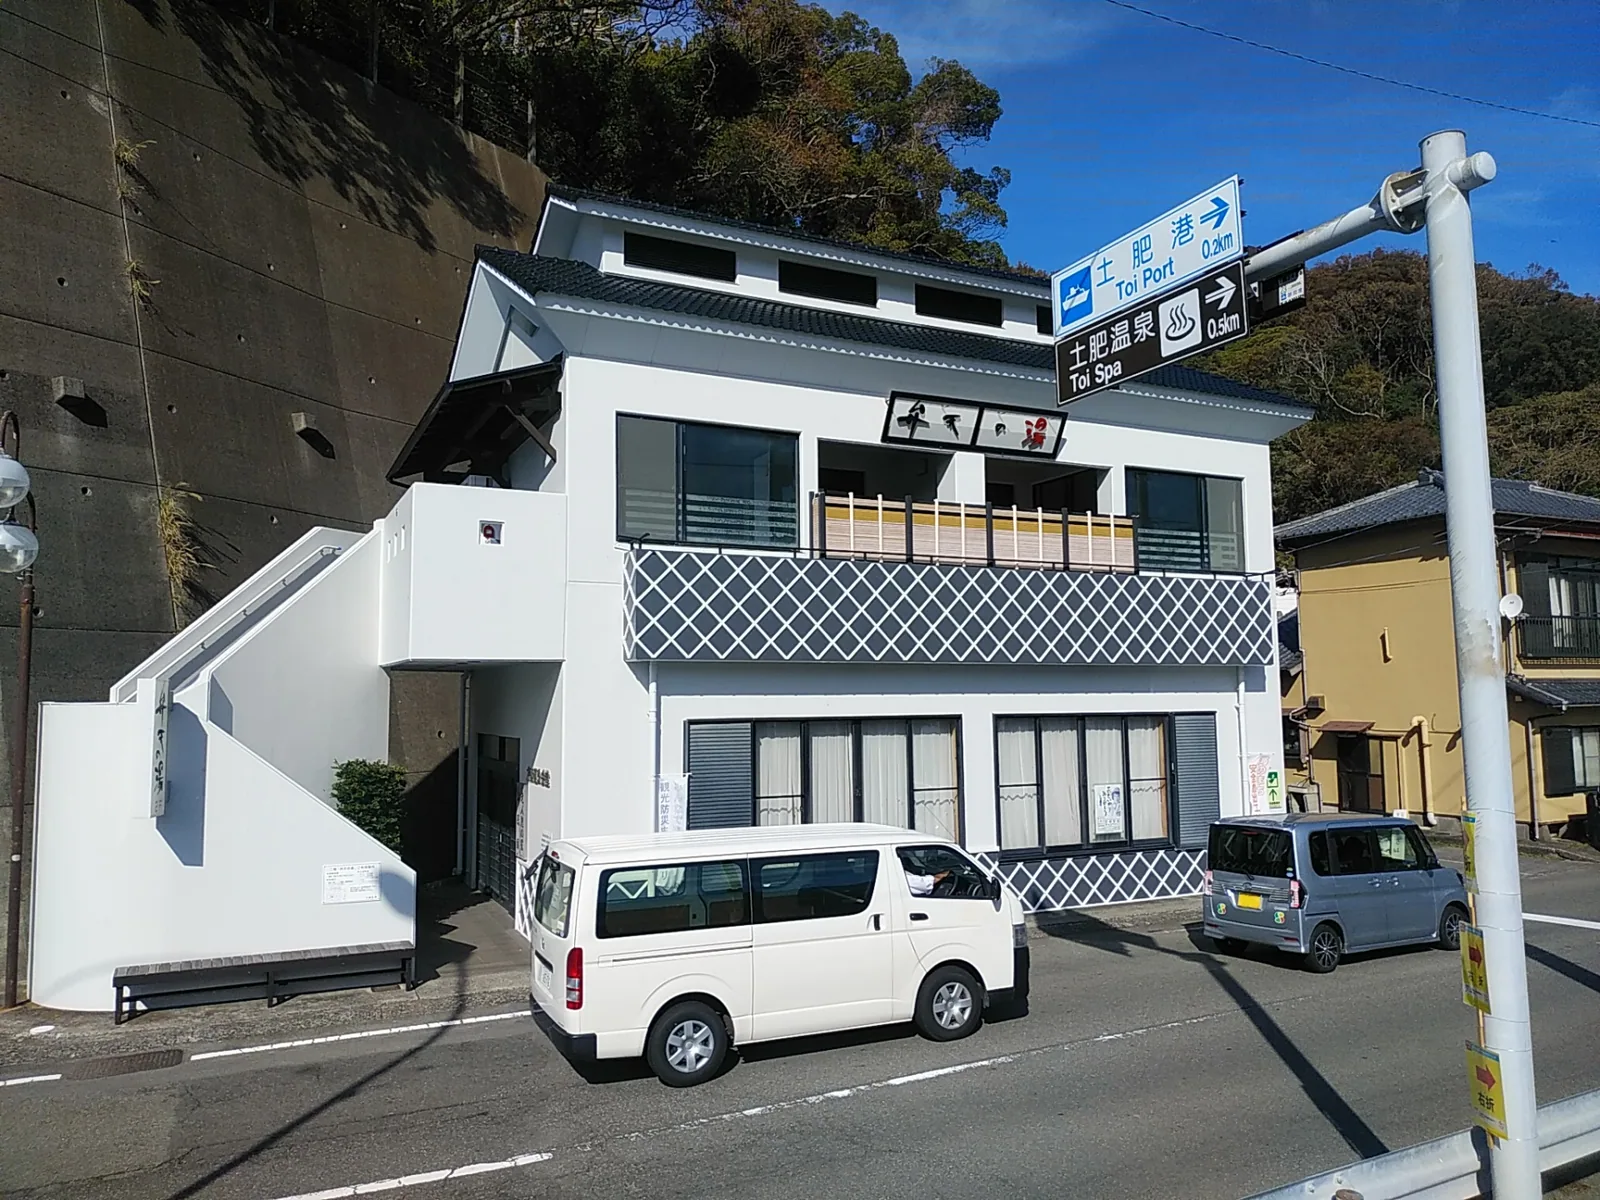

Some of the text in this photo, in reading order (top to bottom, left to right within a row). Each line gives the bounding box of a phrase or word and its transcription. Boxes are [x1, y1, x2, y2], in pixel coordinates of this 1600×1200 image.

[1096, 213, 1194, 288] 土肥港
[1201, 231, 1234, 260] 0.2km
[1115, 257, 1175, 301] Toi Port
[1068, 310, 1156, 372] 土肥温泉
[1207, 312, 1240, 340] 0.5km
[1069, 360, 1122, 394] Toi Spa
[1477, 1091, 1495, 1113] 右折
